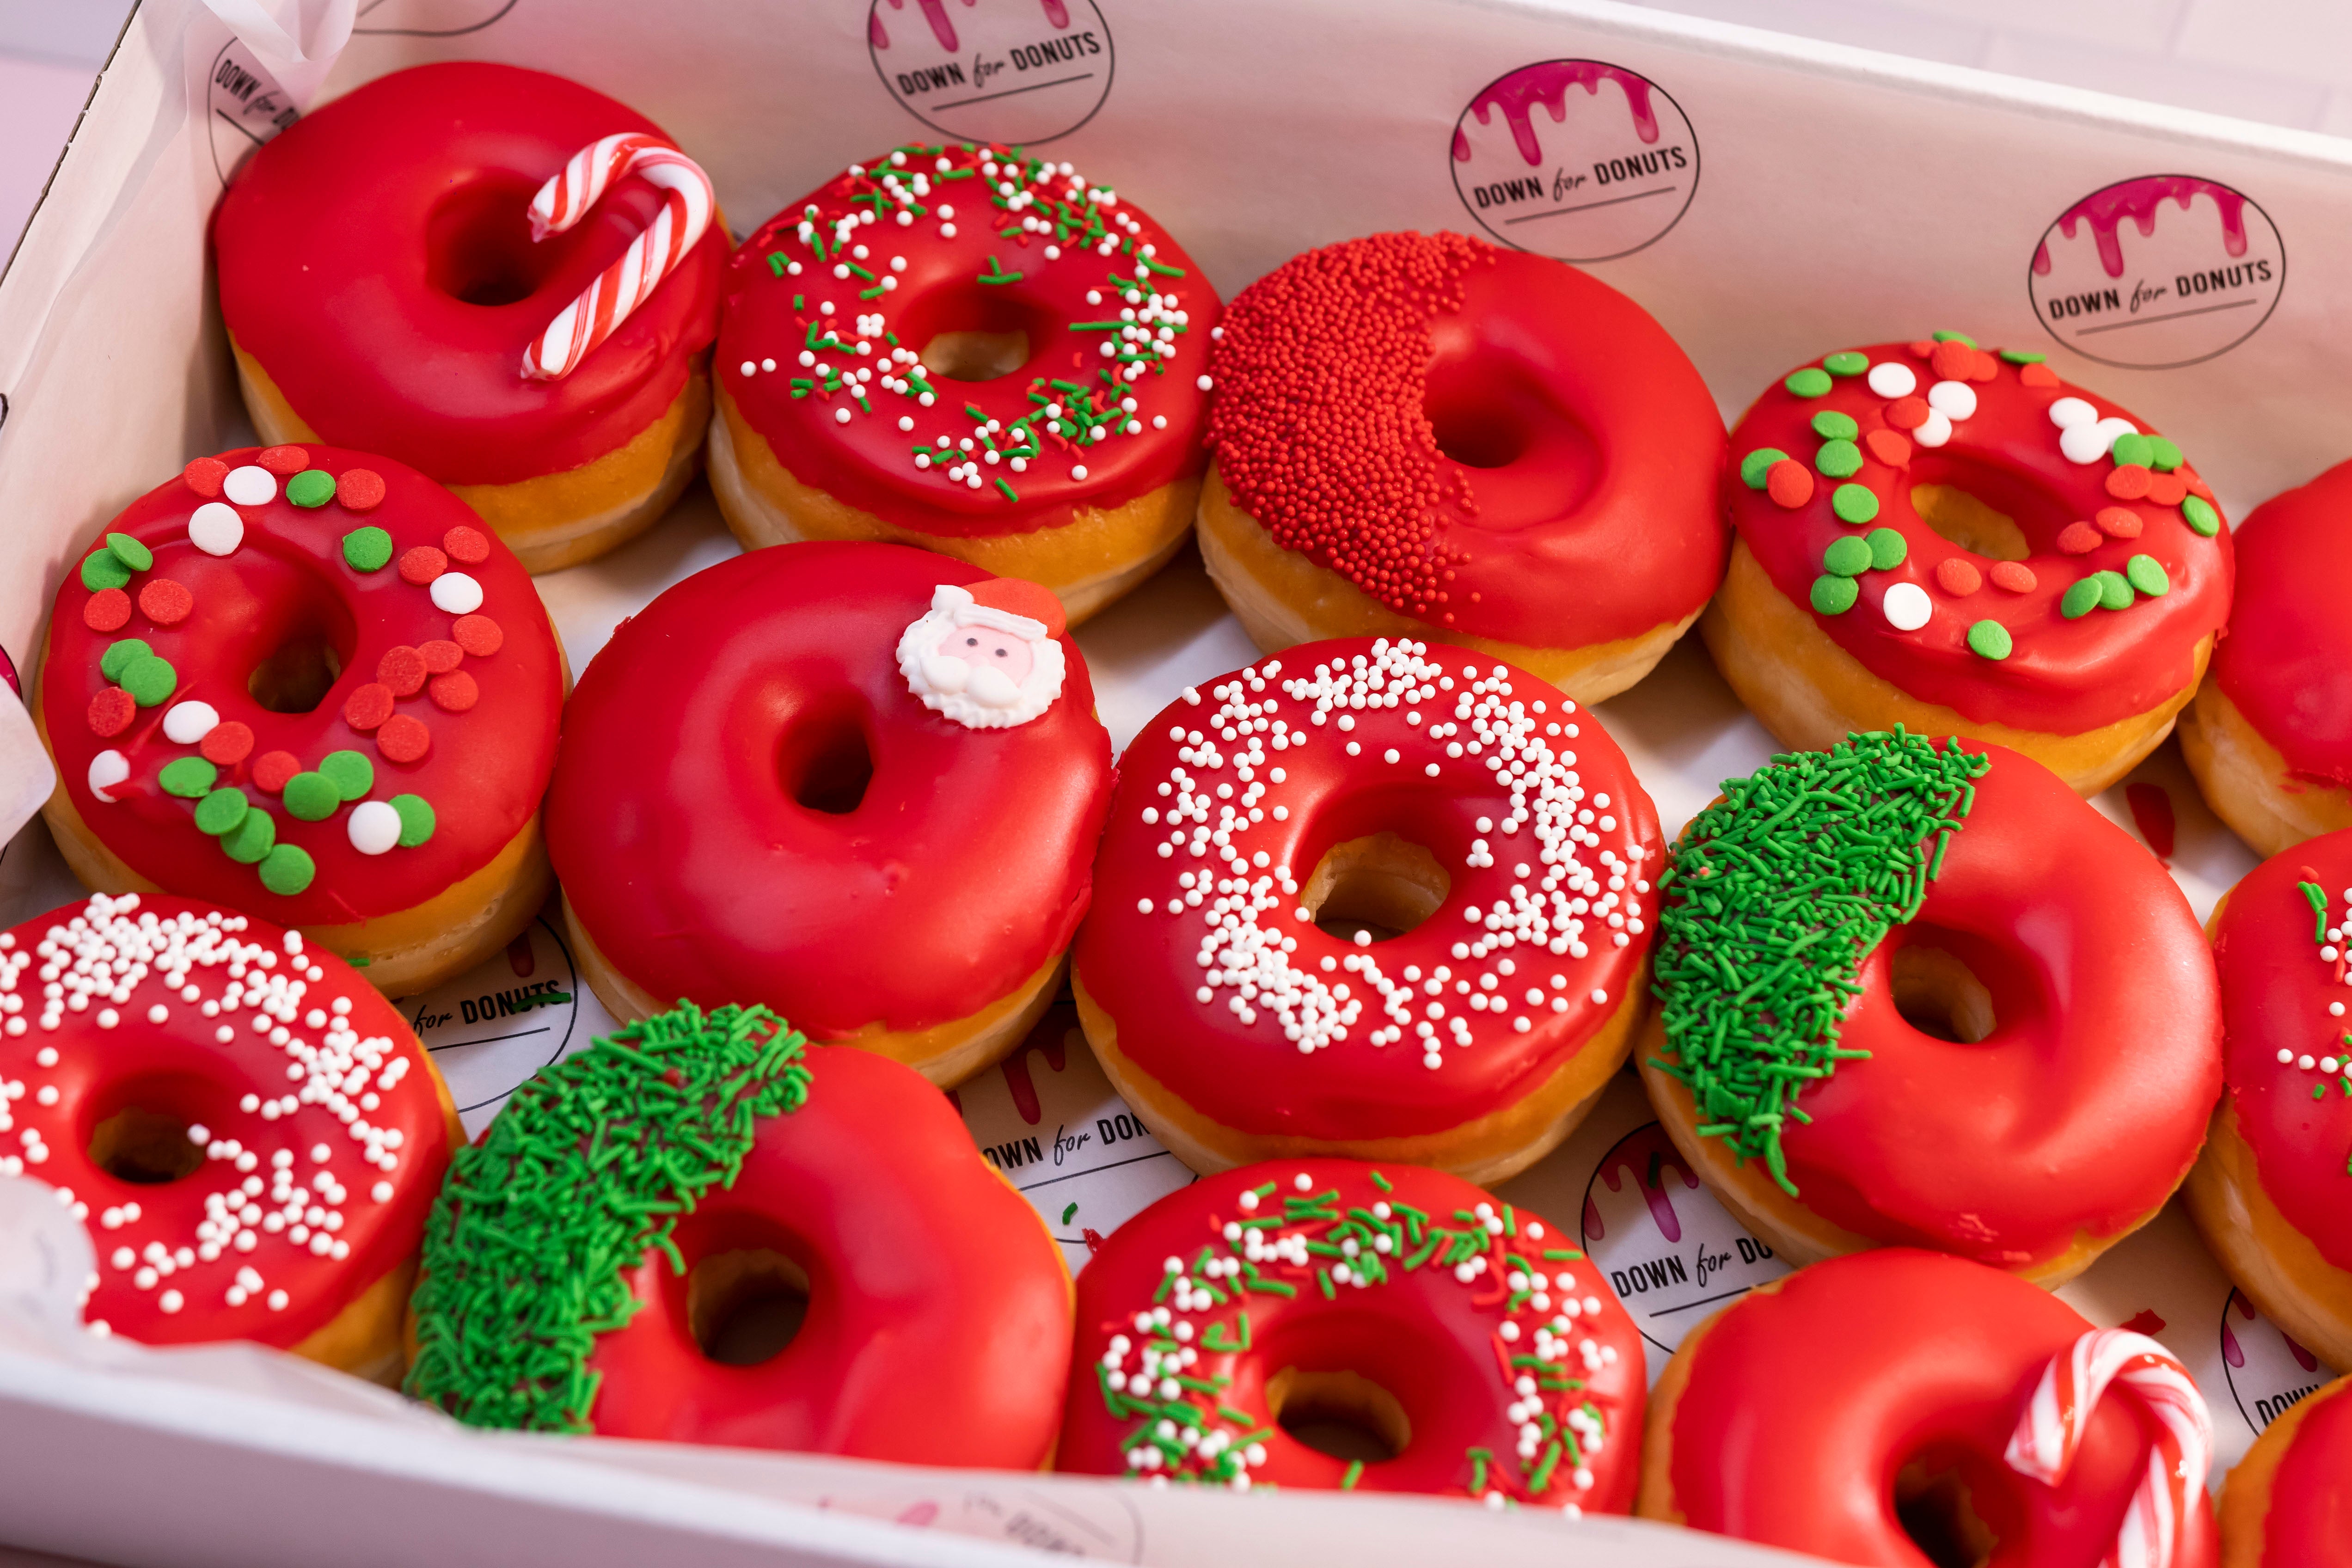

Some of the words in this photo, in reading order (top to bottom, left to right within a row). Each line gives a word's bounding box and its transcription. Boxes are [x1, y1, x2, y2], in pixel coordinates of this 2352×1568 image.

[214, 58, 262, 102] DOWN
[895, 63, 965, 95] DOWN
[973, 54, 1004, 88] for
[1009, 31, 1100, 71] DONUTS
[1473, 177, 1544, 208] DOWN
[1553, 168, 1586, 202] for
[1593, 147, 1687, 185] DONUTS
[2048, 289, 2120, 319] DOWN
[2130, 280, 2167, 313] for
[2175, 260, 2272, 297] DONUTS
[414, 1004, 453, 1037] for
[982, 1136, 1044, 1170] OWN
[1054, 1124, 1091, 1166] for
[1611, 1255, 1688, 1298] DOWN
[1696, 1243, 1732, 1288] for
